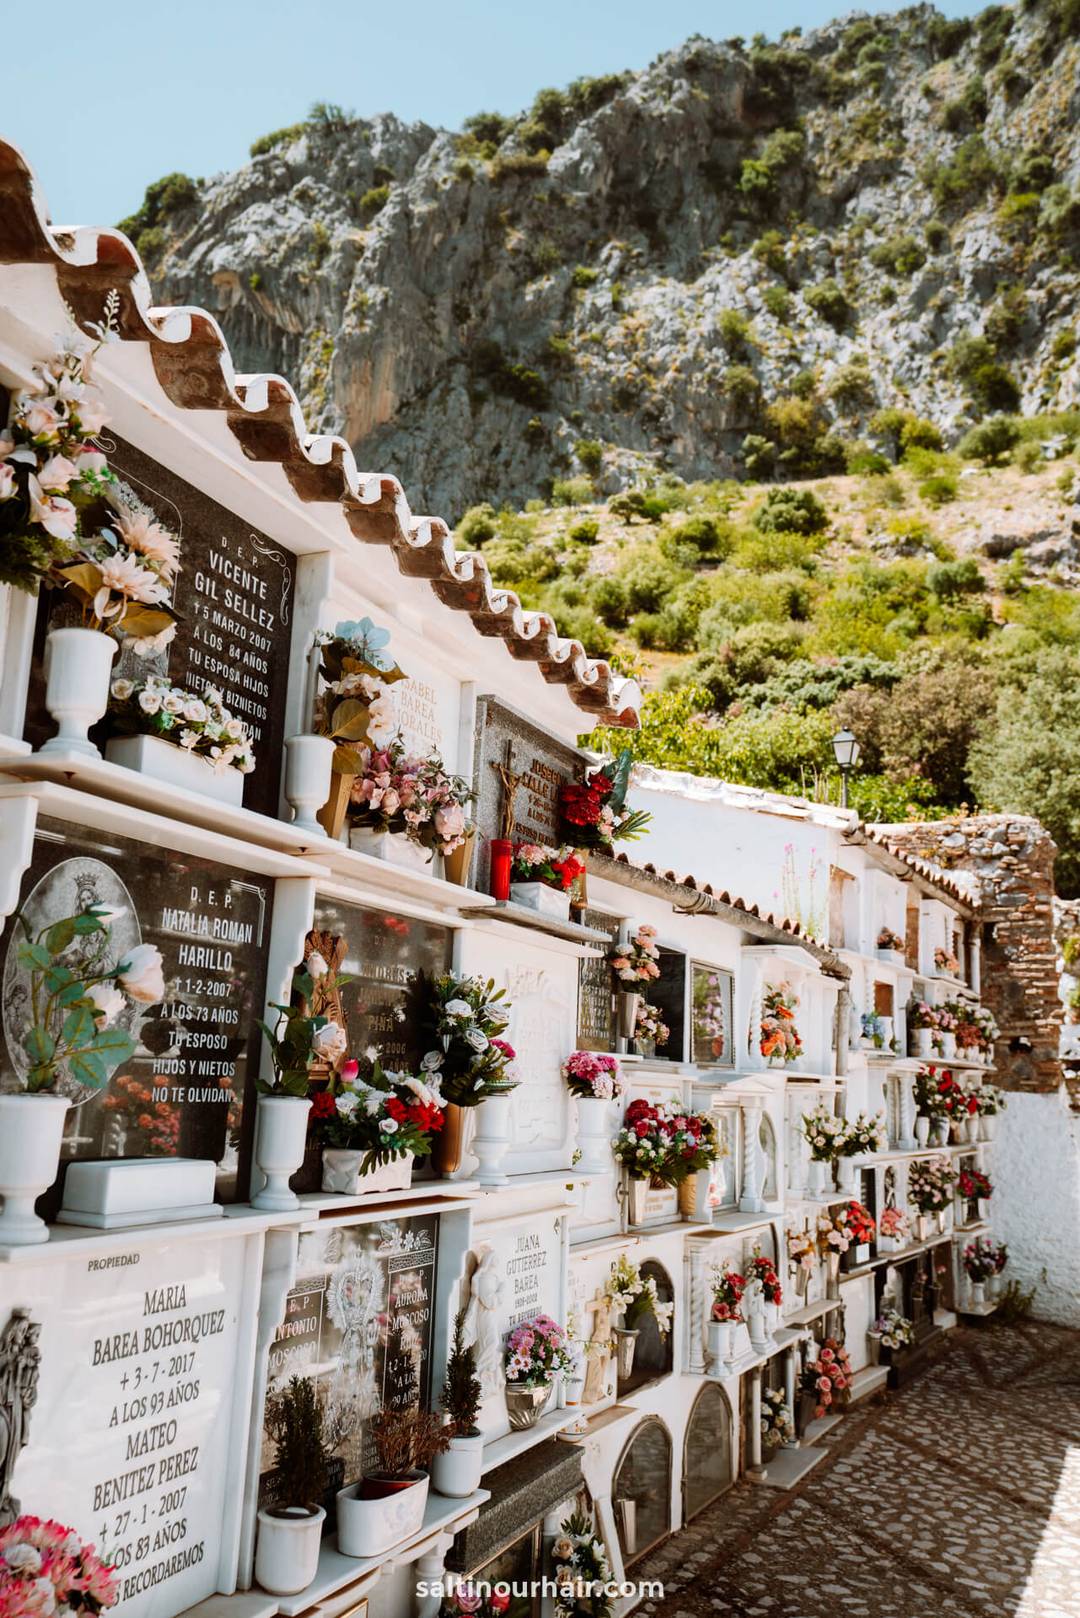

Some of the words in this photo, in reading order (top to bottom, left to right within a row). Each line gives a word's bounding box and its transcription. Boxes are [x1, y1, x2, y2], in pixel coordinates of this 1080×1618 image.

[208, 549, 269, 601] VICENTE
[194, 572, 219, 602] GIL
[224, 587, 275, 632] SELLEZ
[212, 610, 246, 640] MARZO
[249, 630, 272, 653] 2007
[193, 625, 201, 640] A
[203, 633, 223, 652] LOS
[228, 644, 241, 661] 84
[242, 650, 269, 675] AÑOS
[188, 647, 201, 664] TU
[204, 655, 241, 684] ESPOSA
[242, 673, 270, 699] HIJOS
[225, 692, 268, 721] BIZNIETOS
[400, 711, 442, 744] ORALES
[162, 907, 208, 936] NATALIA
[213, 917, 253, 944] ROMAN
[178, 944, 233, 972] HARILLO
[160, 1002, 168, 1019] A
[171, 1004, 193, 1021] LOS
[196, 1006, 209, 1022] 73
[210, 1005, 239, 1025] AÑOS
[168, 1030, 184, 1047] TU
[186, 1032, 228, 1050] ESPOSO
[152, 1058, 186, 1075] HIJOS
[189, 1060, 196, 1076] Y
[198, 1060, 236, 1077] NIETOS
[151, 1086, 168, 1103] NO
[171, 1087, 185, 1103] TE
[187, 1087, 233, 1103] OLVIDAN
[514, 1233, 541, 1254] JUANA
[87, 1252, 141, 1272] PROPIEDAD
[506, 1250, 548, 1276] GUTIERREZ
[142, 1284, 187, 1317] MARIA
[395, 1287, 429, 1309] AURORA
[514, 1274, 539, 1294] BAREA
[92, 1329, 139, 1367] BAREA
[142, 1309, 226, 1353] BOHORQUEZ
[275, 1315, 317, 1342] NTONIO
[108, 1407, 119, 1428] A
[122, 1396, 147, 1424] LOS
[150, 1391, 164, 1416] 93
[166, 1379, 200, 1409] AÑOS
[125, 1418, 178, 1461] MATEO
[93, 1463, 156, 1512] BENITEZ
[157, 1446, 199, 1486] PEREZ
[135, 1536, 151, 1561] 83
[152, 1518, 188, 1553] AÑOS
[122, 1541, 206, 1602] RECORDAREMOS
